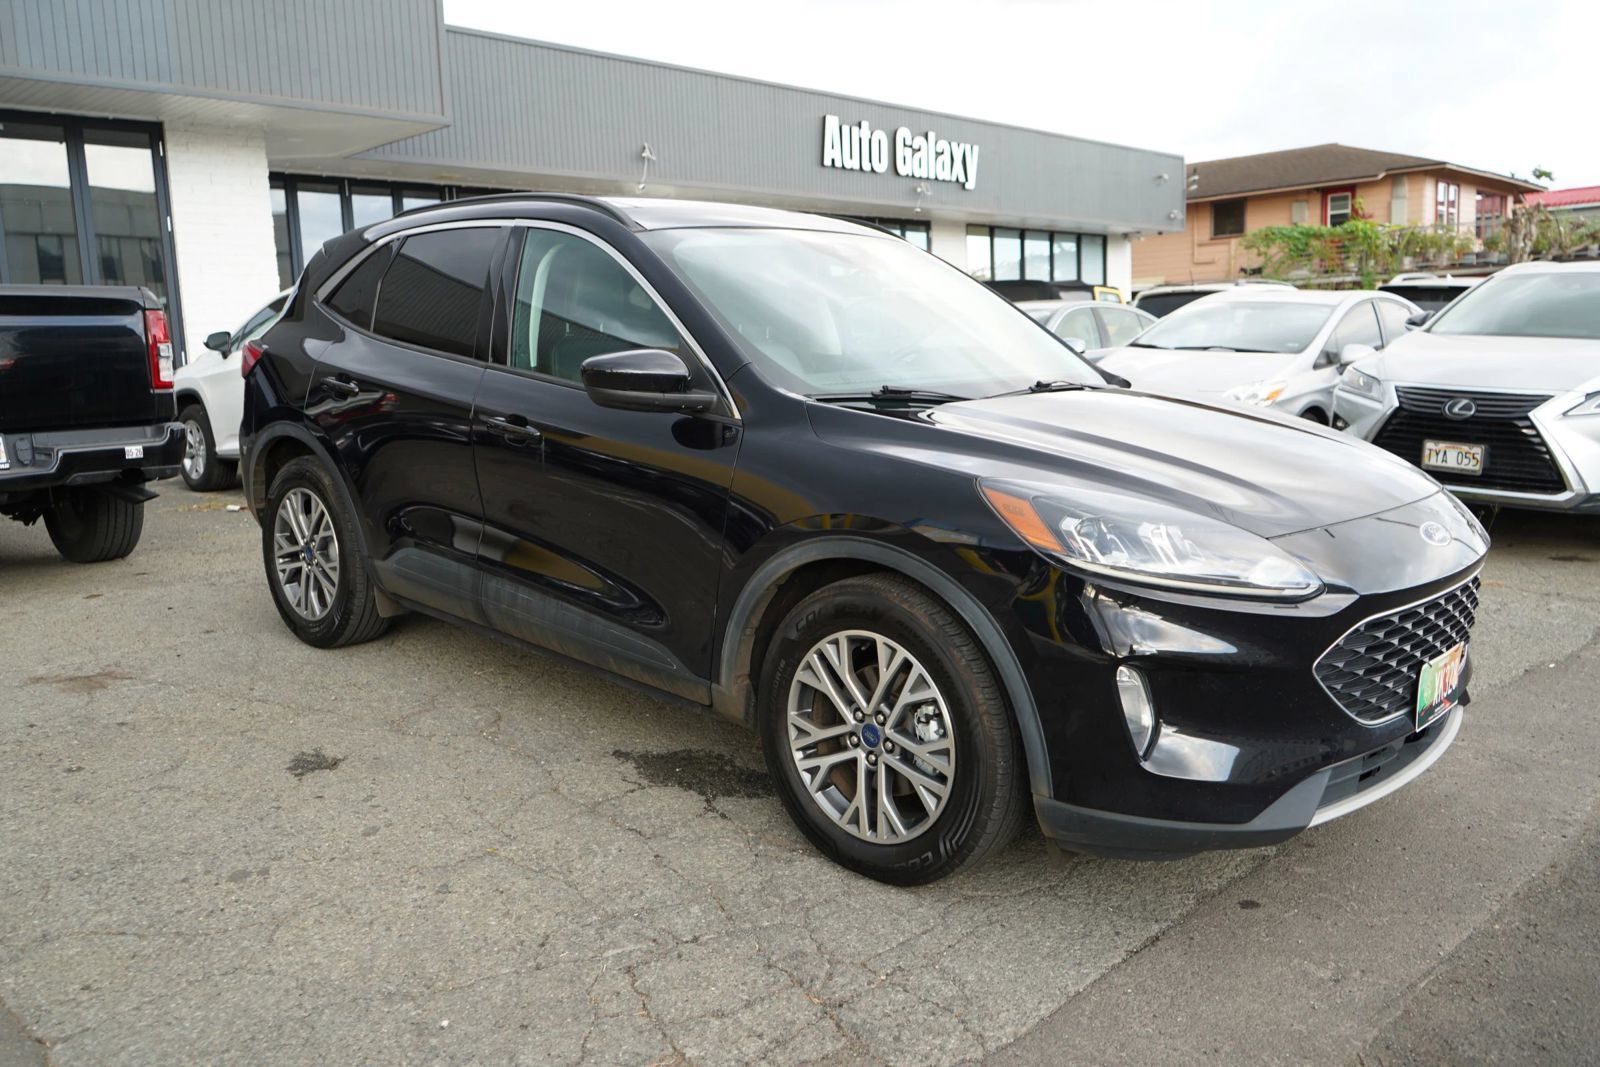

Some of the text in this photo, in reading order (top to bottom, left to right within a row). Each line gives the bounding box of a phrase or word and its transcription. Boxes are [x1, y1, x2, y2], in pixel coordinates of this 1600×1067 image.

[823, 114, 979, 190] Auto Galaxy
[1427, 448, 1480, 467] TYA 055
